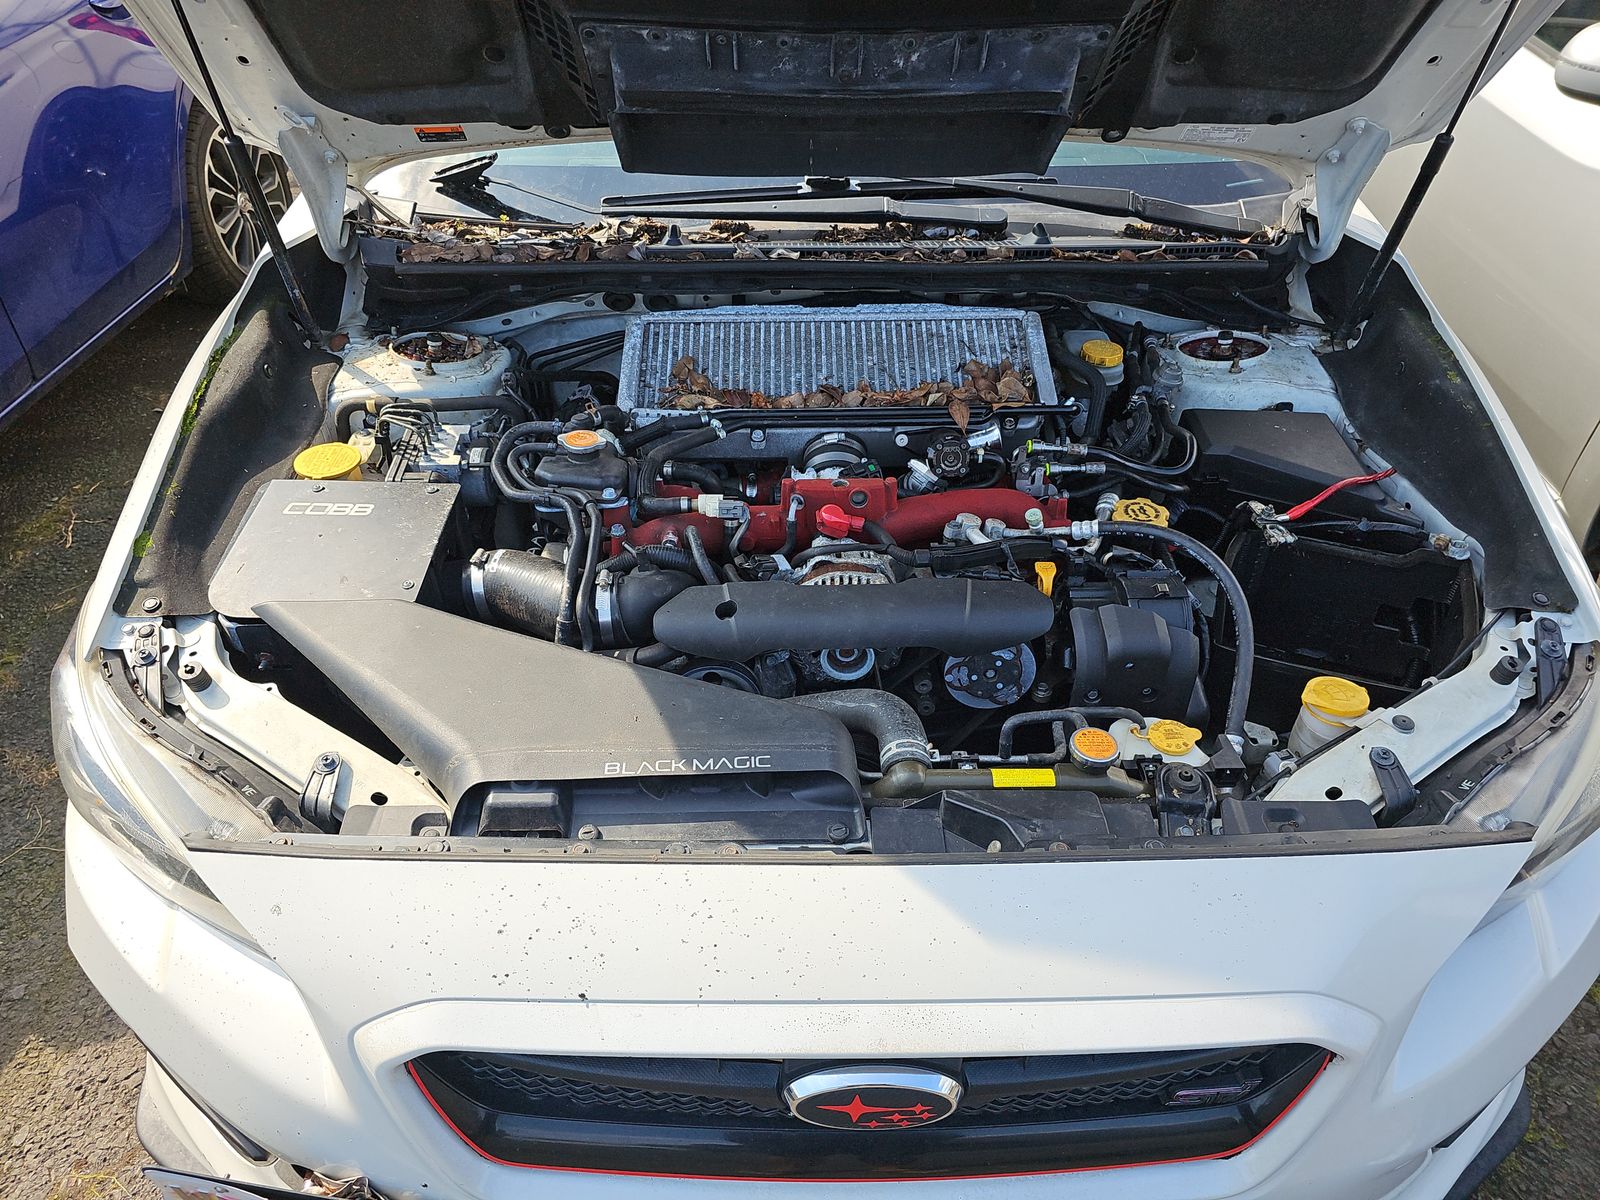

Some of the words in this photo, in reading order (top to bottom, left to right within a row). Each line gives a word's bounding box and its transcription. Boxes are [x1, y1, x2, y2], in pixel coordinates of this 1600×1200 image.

[282, 502, 375, 516] COBB
[604, 758, 687, 775] BLACK
[692, 755, 772, 771] MAGIC
